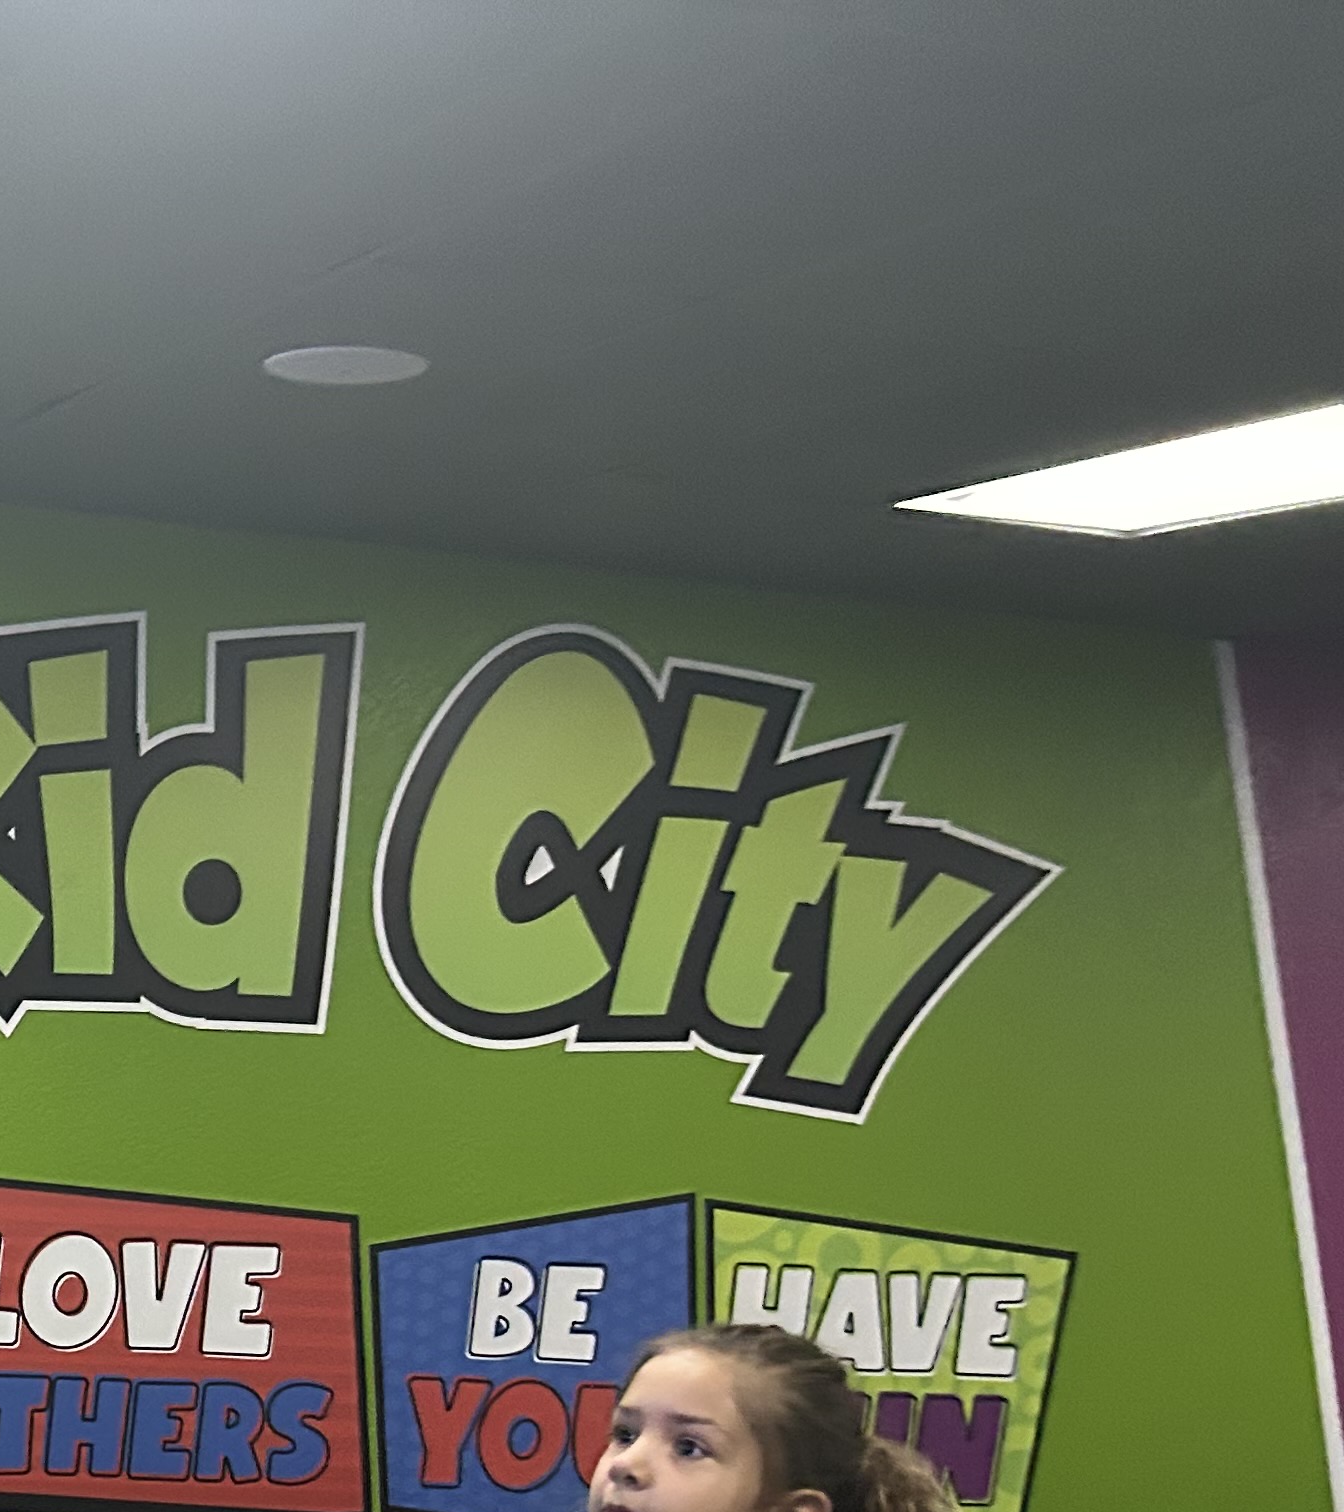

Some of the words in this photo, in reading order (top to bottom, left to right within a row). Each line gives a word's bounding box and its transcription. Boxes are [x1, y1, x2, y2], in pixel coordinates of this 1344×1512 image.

[398, 640, 1004, 1094] City
[465, 1255, 607, 1366] BE
[729, 1262, 1028, 1381] HAVE
